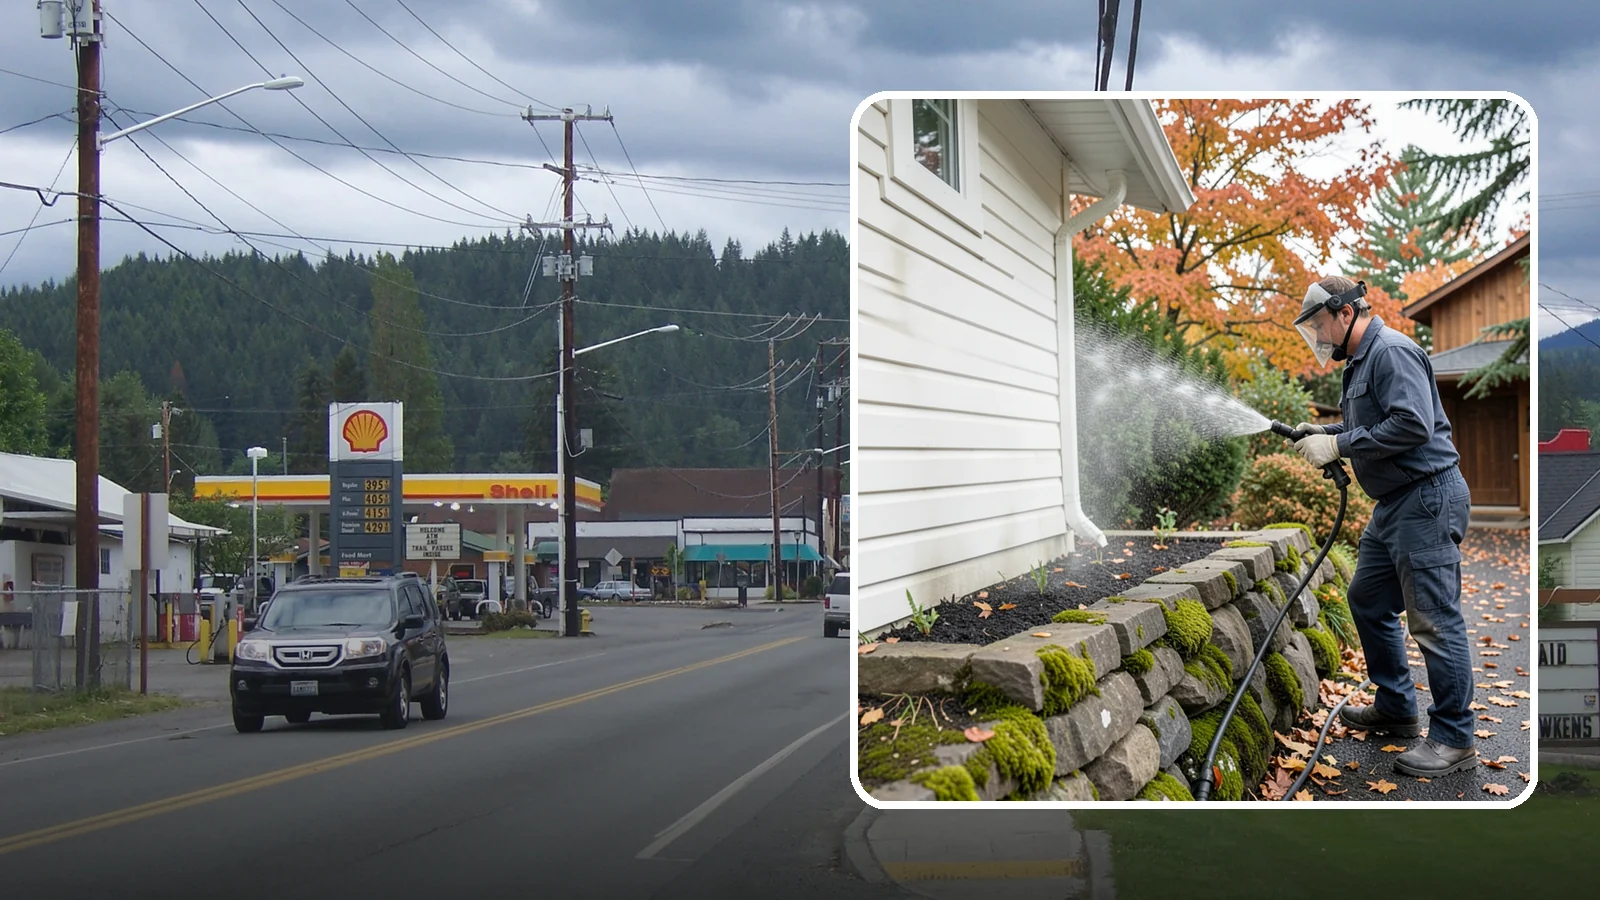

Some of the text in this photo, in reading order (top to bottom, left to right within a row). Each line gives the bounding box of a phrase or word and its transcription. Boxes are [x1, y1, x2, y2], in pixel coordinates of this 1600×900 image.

[366, 480, 383, 490] 395
[490, 485, 547, 499] Shell
[366, 494, 383, 504] 405
[366, 508, 383, 518] 415
[366, 522, 383, 532] 429
[1539, 643, 1567, 666] AID
